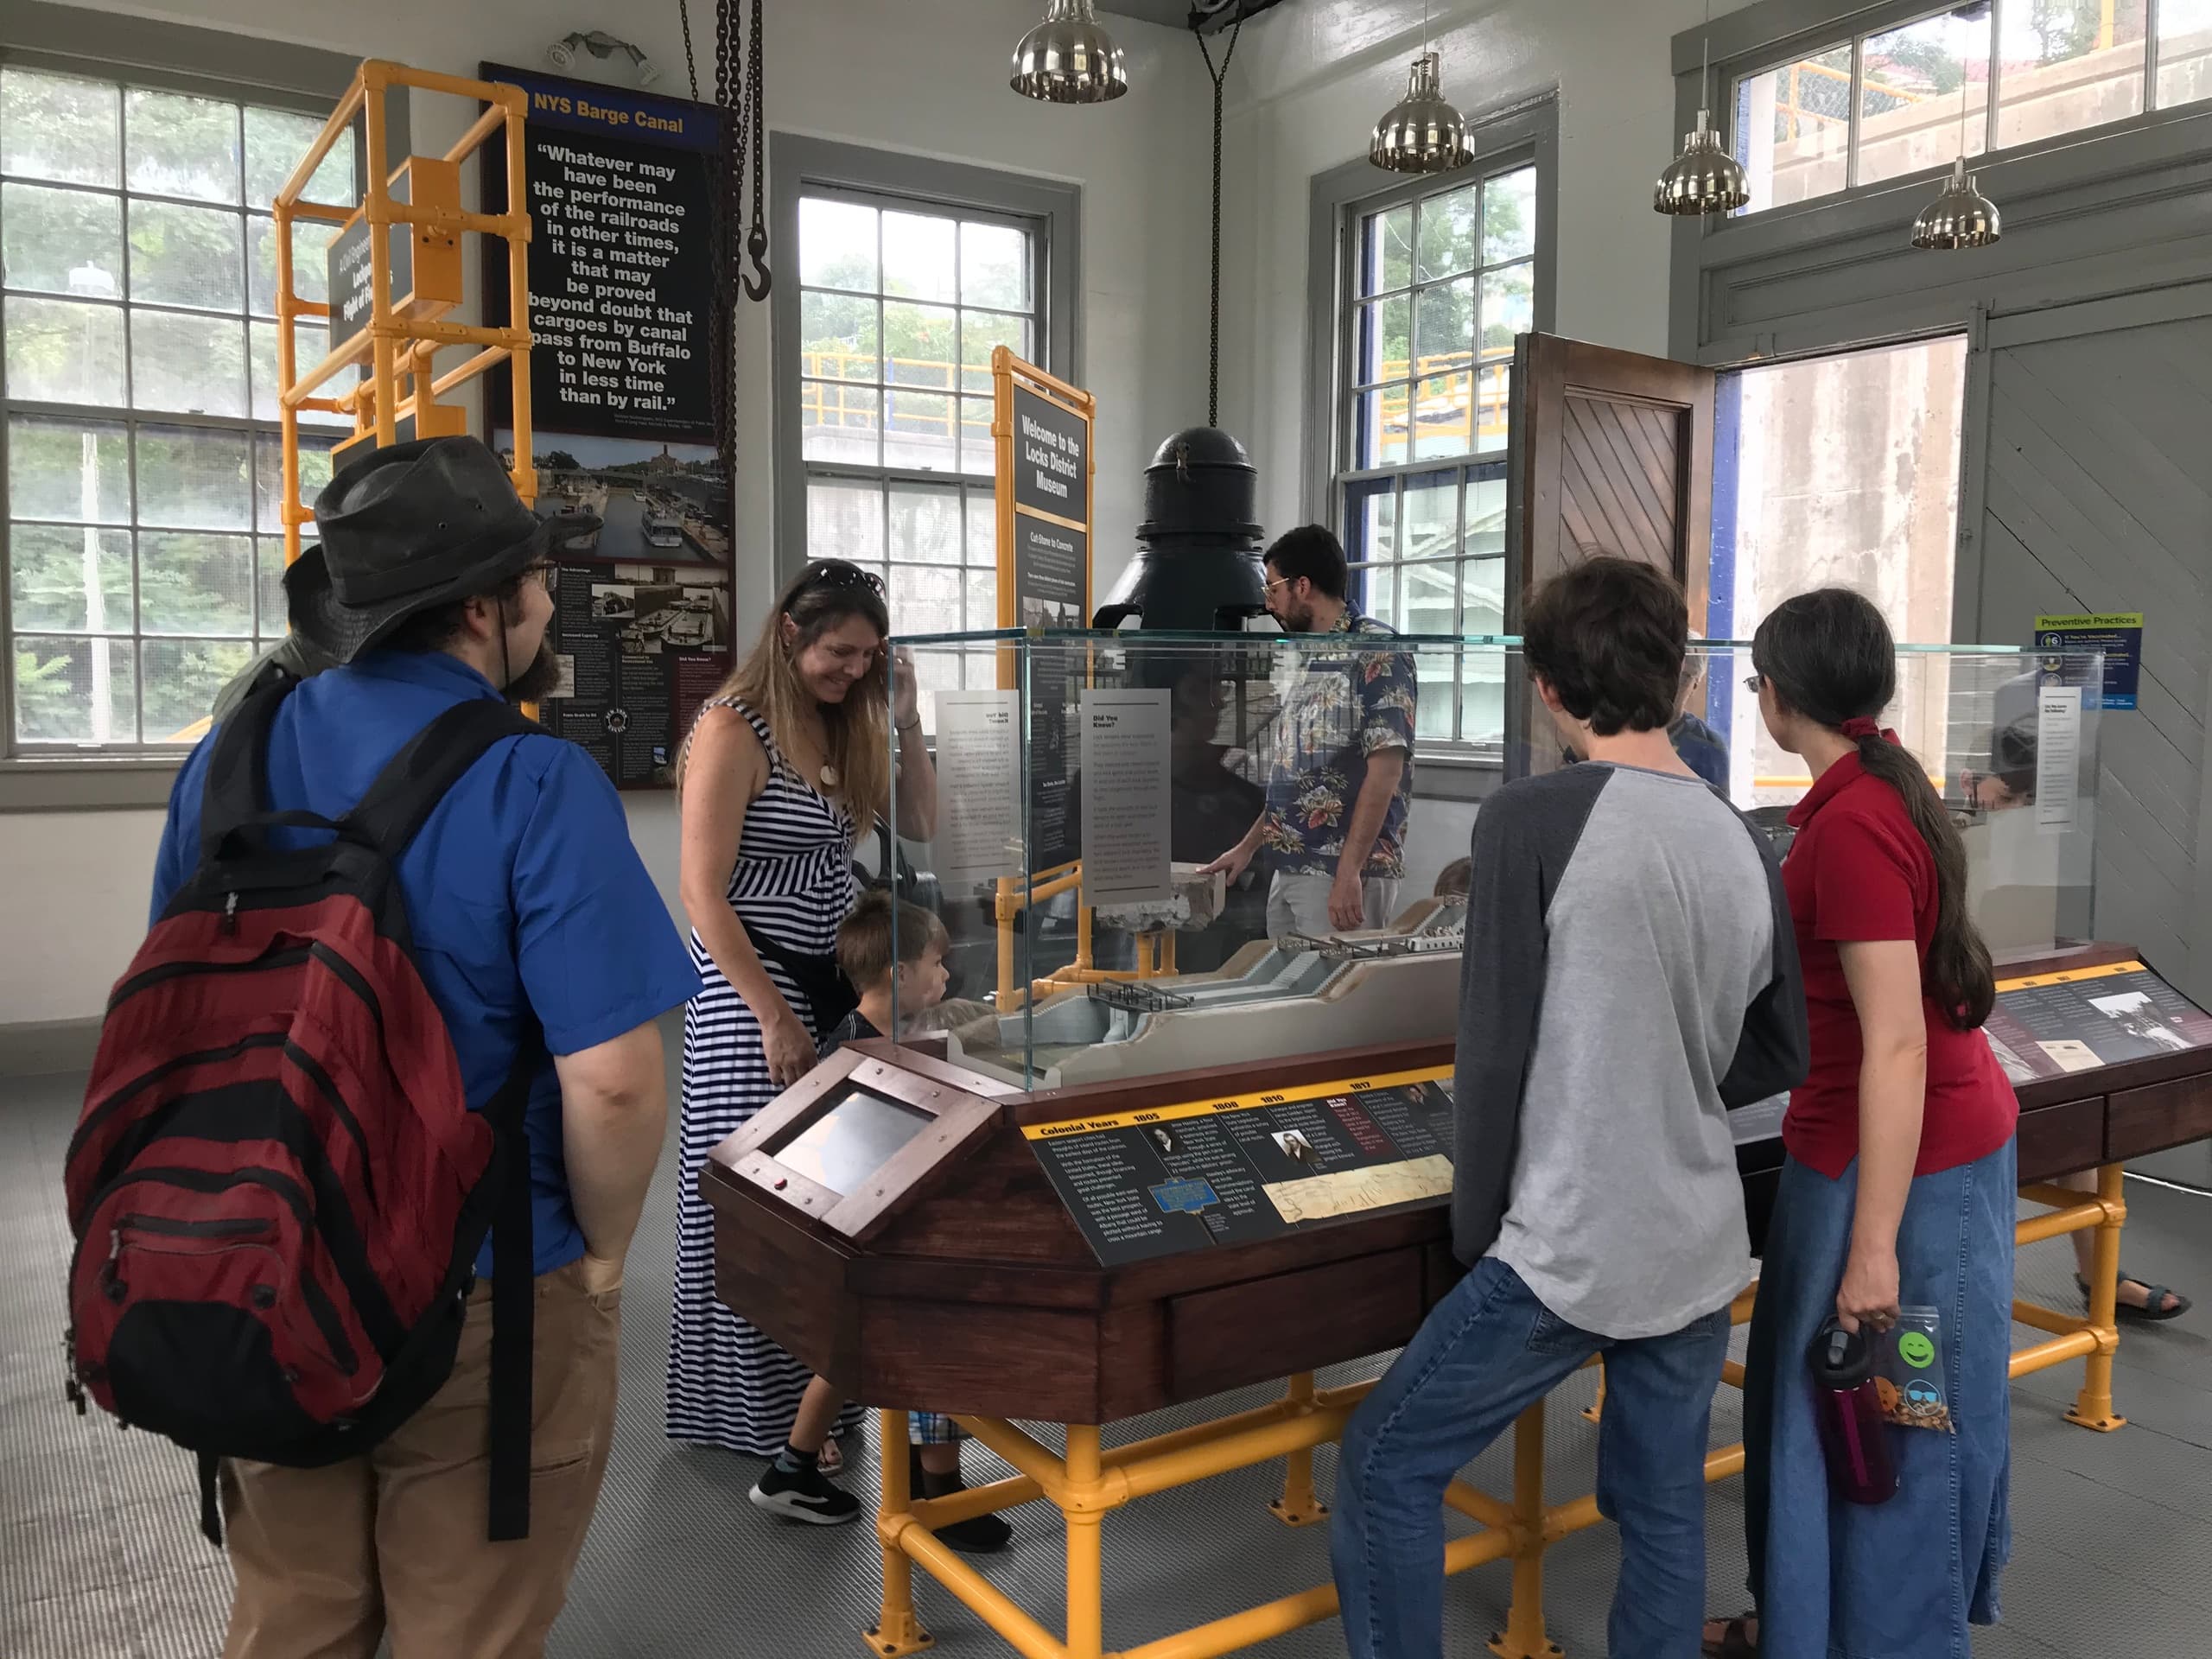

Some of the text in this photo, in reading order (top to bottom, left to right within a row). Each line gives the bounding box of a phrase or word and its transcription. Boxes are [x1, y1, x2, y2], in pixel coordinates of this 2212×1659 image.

[534, 93, 683, 133] NYS Barge Canal
[564, 166, 656, 194] have been
[639, 162, 676, 182] may
[533, 182, 685, 216] the performance
[541, 202, 679, 234] of the railroads
[547, 220, 679, 255] in other times,
[552, 240, 669, 268] it is a matter
[571, 261, 651, 286] that may
[567, 278, 656, 303] be proved
[344, 296, 358, 322] Flight
[359, 289, 364, 309] of
[528, 292, 693, 324] beyond doubt that
[534, 313, 687, 342] cargoes by canal
[531, 332, 691, 360] pass from Buffalo
[557, 350, 667, 375] to New York
[560, 369, 664, 392] in less time
[560, 388, 601, 405] than
[607, 393, 628, 410] by
[1022, 414, 1079, 457] Welcome to the
[1026, 440, 1077, 480] Locks District
[1036, 470, 1068, 499] Museum
[1030, 532, 1073, 553] Cut-Stone to Concrete
[1261, 1094, 1285, 1104] 1810
[1350, 1081, 1371, 1091] 1817
[1134, 1112, 1160, 1123] 1805
[1213, 1101, 1239, 1111] 1808
[1040, 1118, 1119, 1135] Colonial Years
